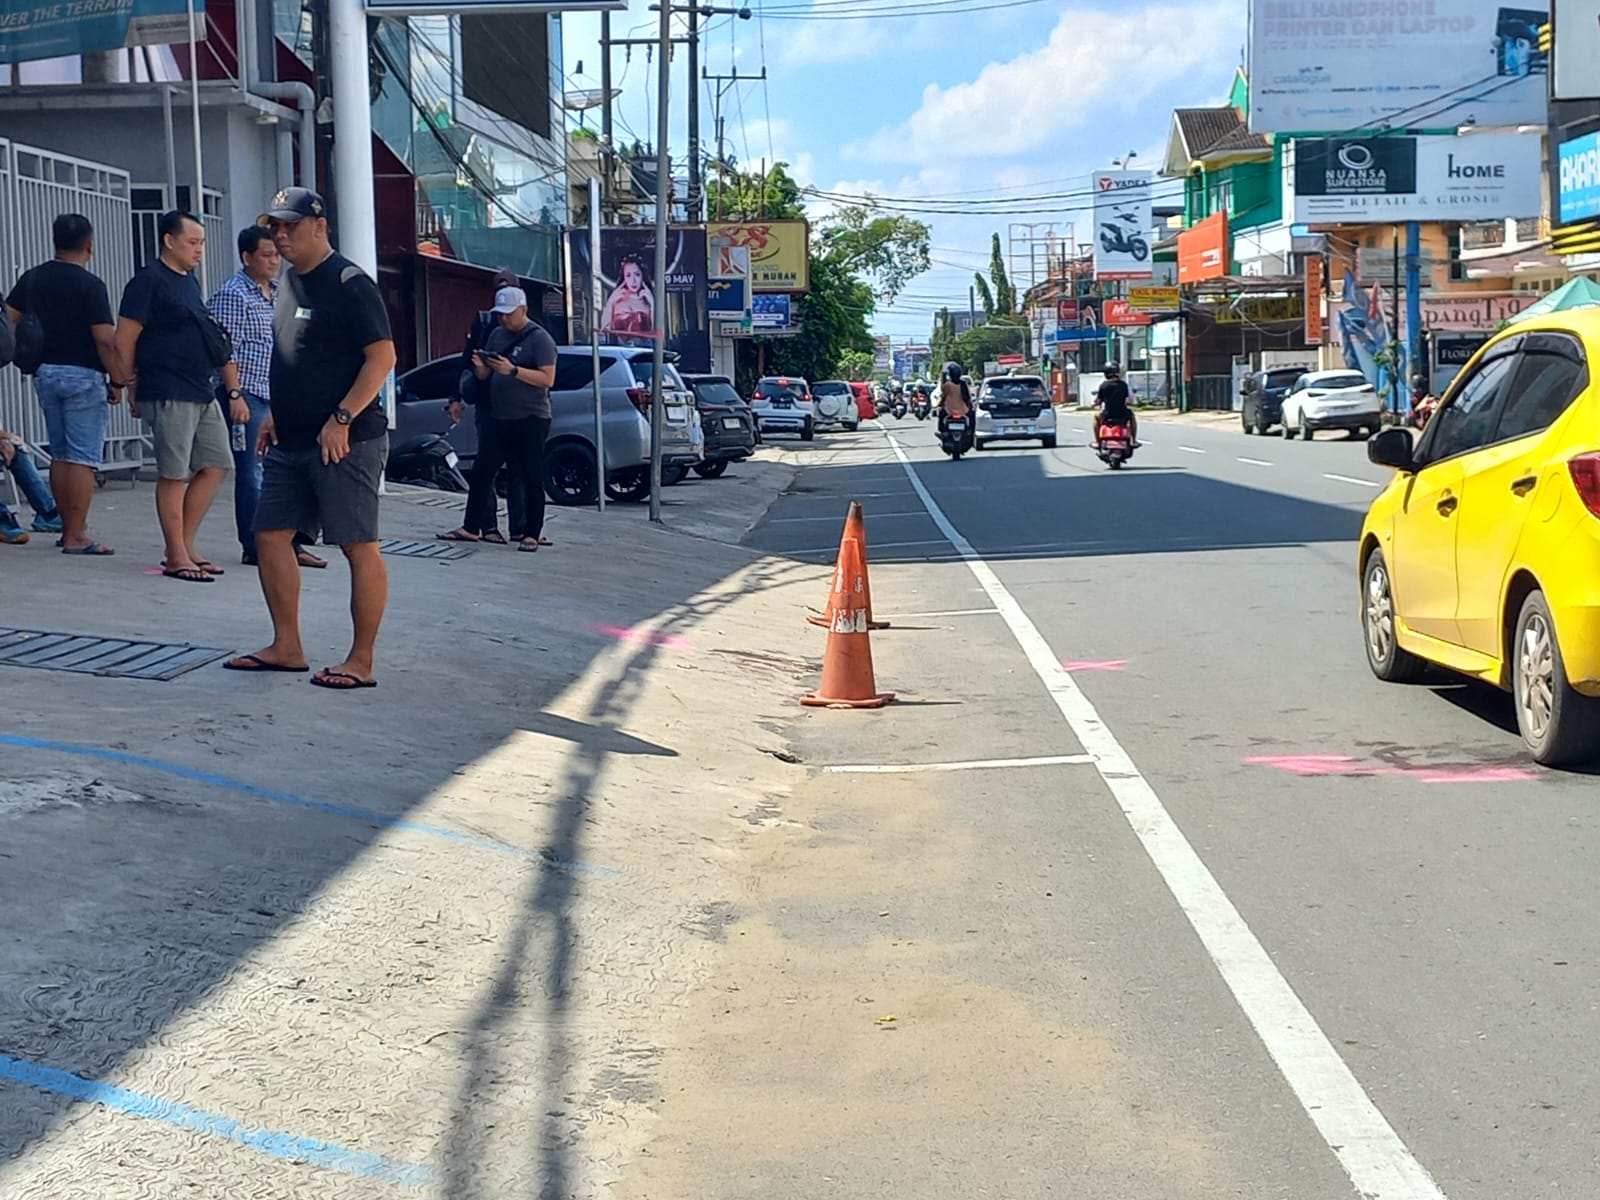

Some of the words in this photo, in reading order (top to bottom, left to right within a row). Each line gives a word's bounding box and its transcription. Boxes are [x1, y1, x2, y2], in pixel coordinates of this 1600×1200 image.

[1312, 0, 1436, 17] HANDPHONE
[33, 8, 61, 21] THE
[1264, 20, 1345, 36] PRINTER
[1352, 19, 1393, 35] DAN
[1400, 17, 1476, 33] LAPTOP
[1326, 169, 1387, 179] NUANSA
[1326, 178, 1387, 187] SUPERSTORE
[1350, 196, 1409, 207] RETAIL
[1419, 196, 1428, 206] &
[673, 274, 694, 284] MAY
